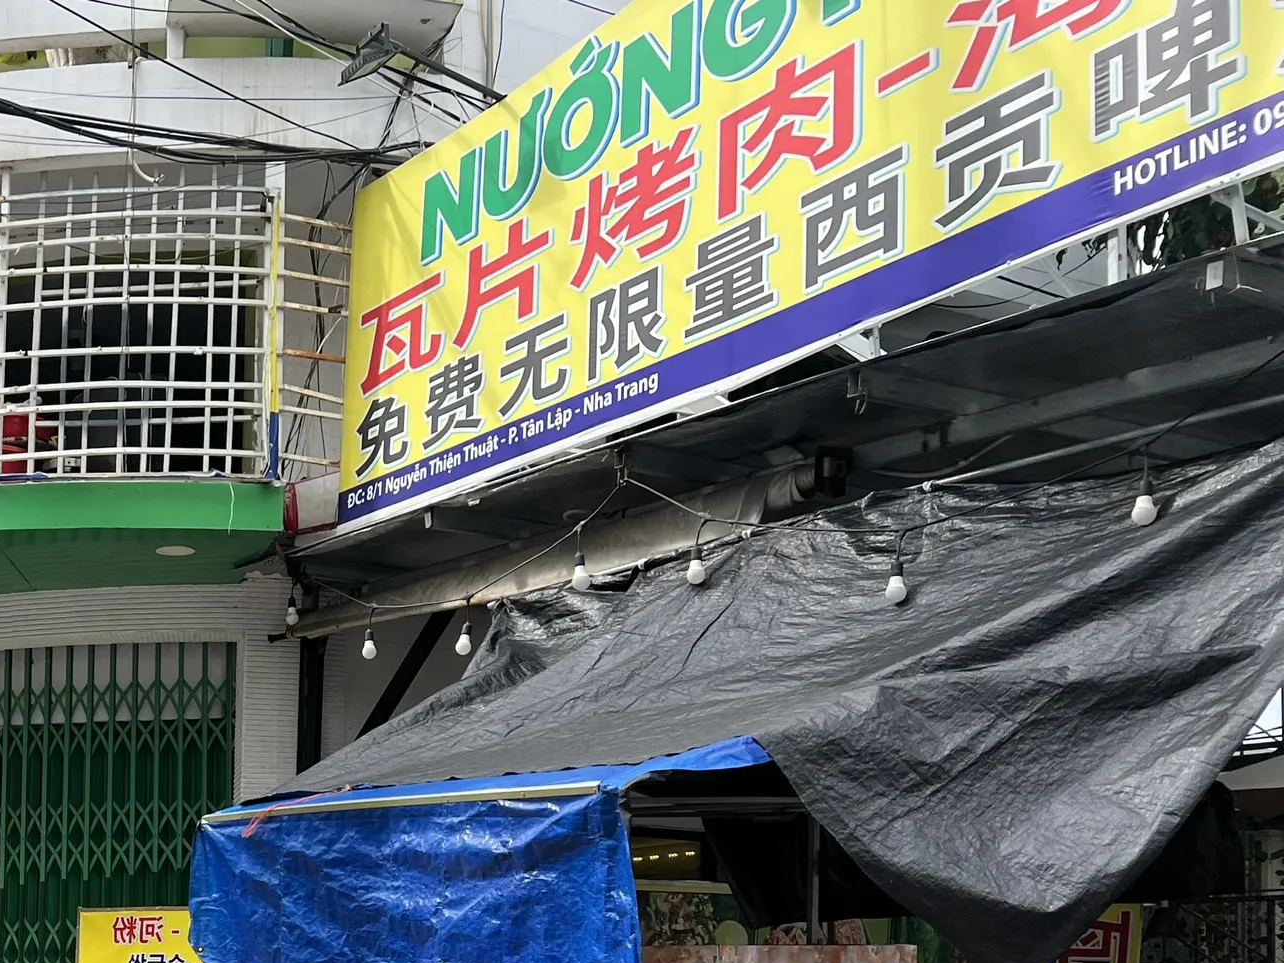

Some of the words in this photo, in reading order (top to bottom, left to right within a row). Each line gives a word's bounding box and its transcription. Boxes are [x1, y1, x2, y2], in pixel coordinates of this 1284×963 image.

[421, 0, 791, 263] NƯỚNG
[1113, 119, 1247, 195] HOTLINE:
[355, 0, 1284, 478] 免费无限量西贡啤
[347, 491, 366, 509] ĐC:
[366, 483, 383, 502] 8/1
[385, 460, 427, 498] Nguyễn
[429, 450, 462, 474] Thiện
[463, 434, 500, 463] Thuật
[508, 430, 519, 446] P.
[520, 415, 545, 440] Tân
[547, 407, 572, 434] Lập
[583, 394, 613, 416] Nha
[614, 372, 659, 404] Trang
